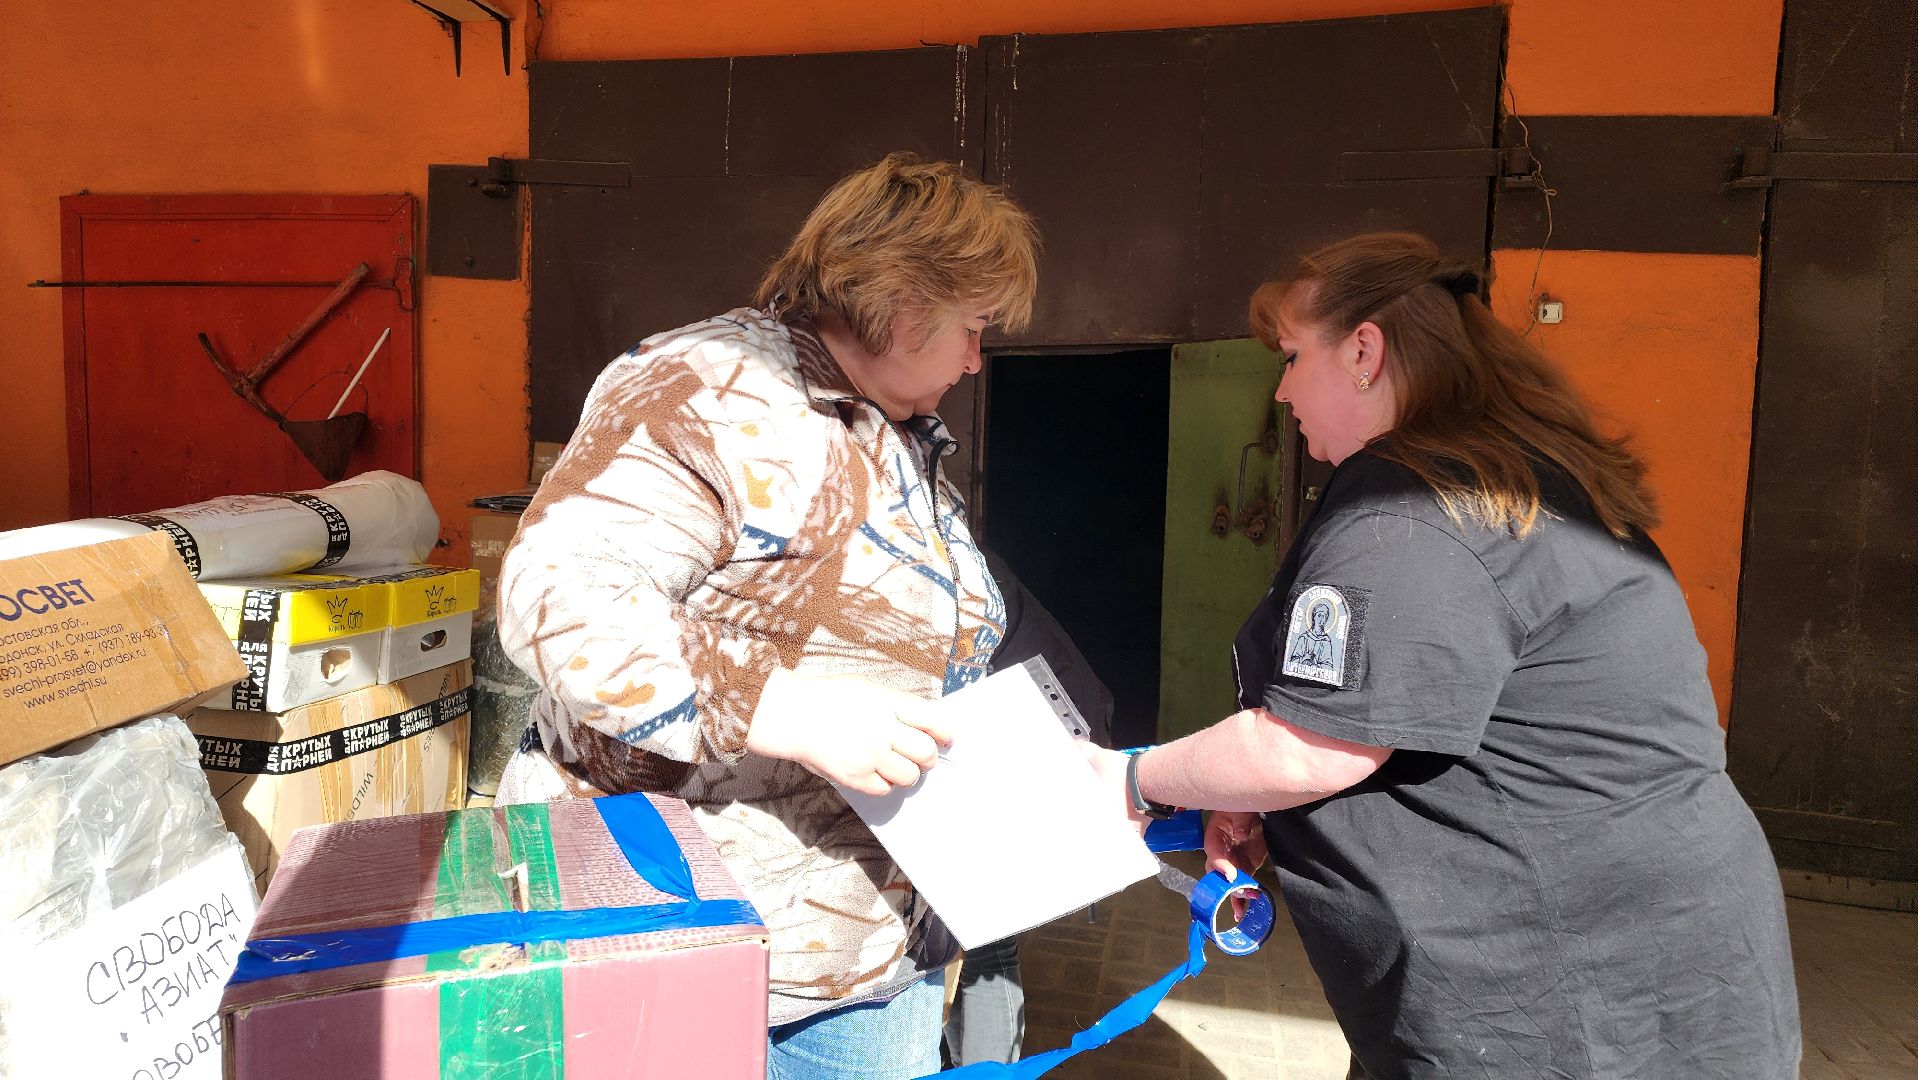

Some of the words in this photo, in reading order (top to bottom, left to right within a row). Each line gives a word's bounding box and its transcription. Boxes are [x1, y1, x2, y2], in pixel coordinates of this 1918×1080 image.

[0, 579, 96, 621] ОСВЕТ
[65, 623, 124, 645] Складская
[23, 676, 107, 709] www.svechi.su
[350, 719, 389, 741] КРУТЫХ
[281, 734, 332, 760] КРУТЫХ
[86, 892, 241, 1005] СВОБОДА
